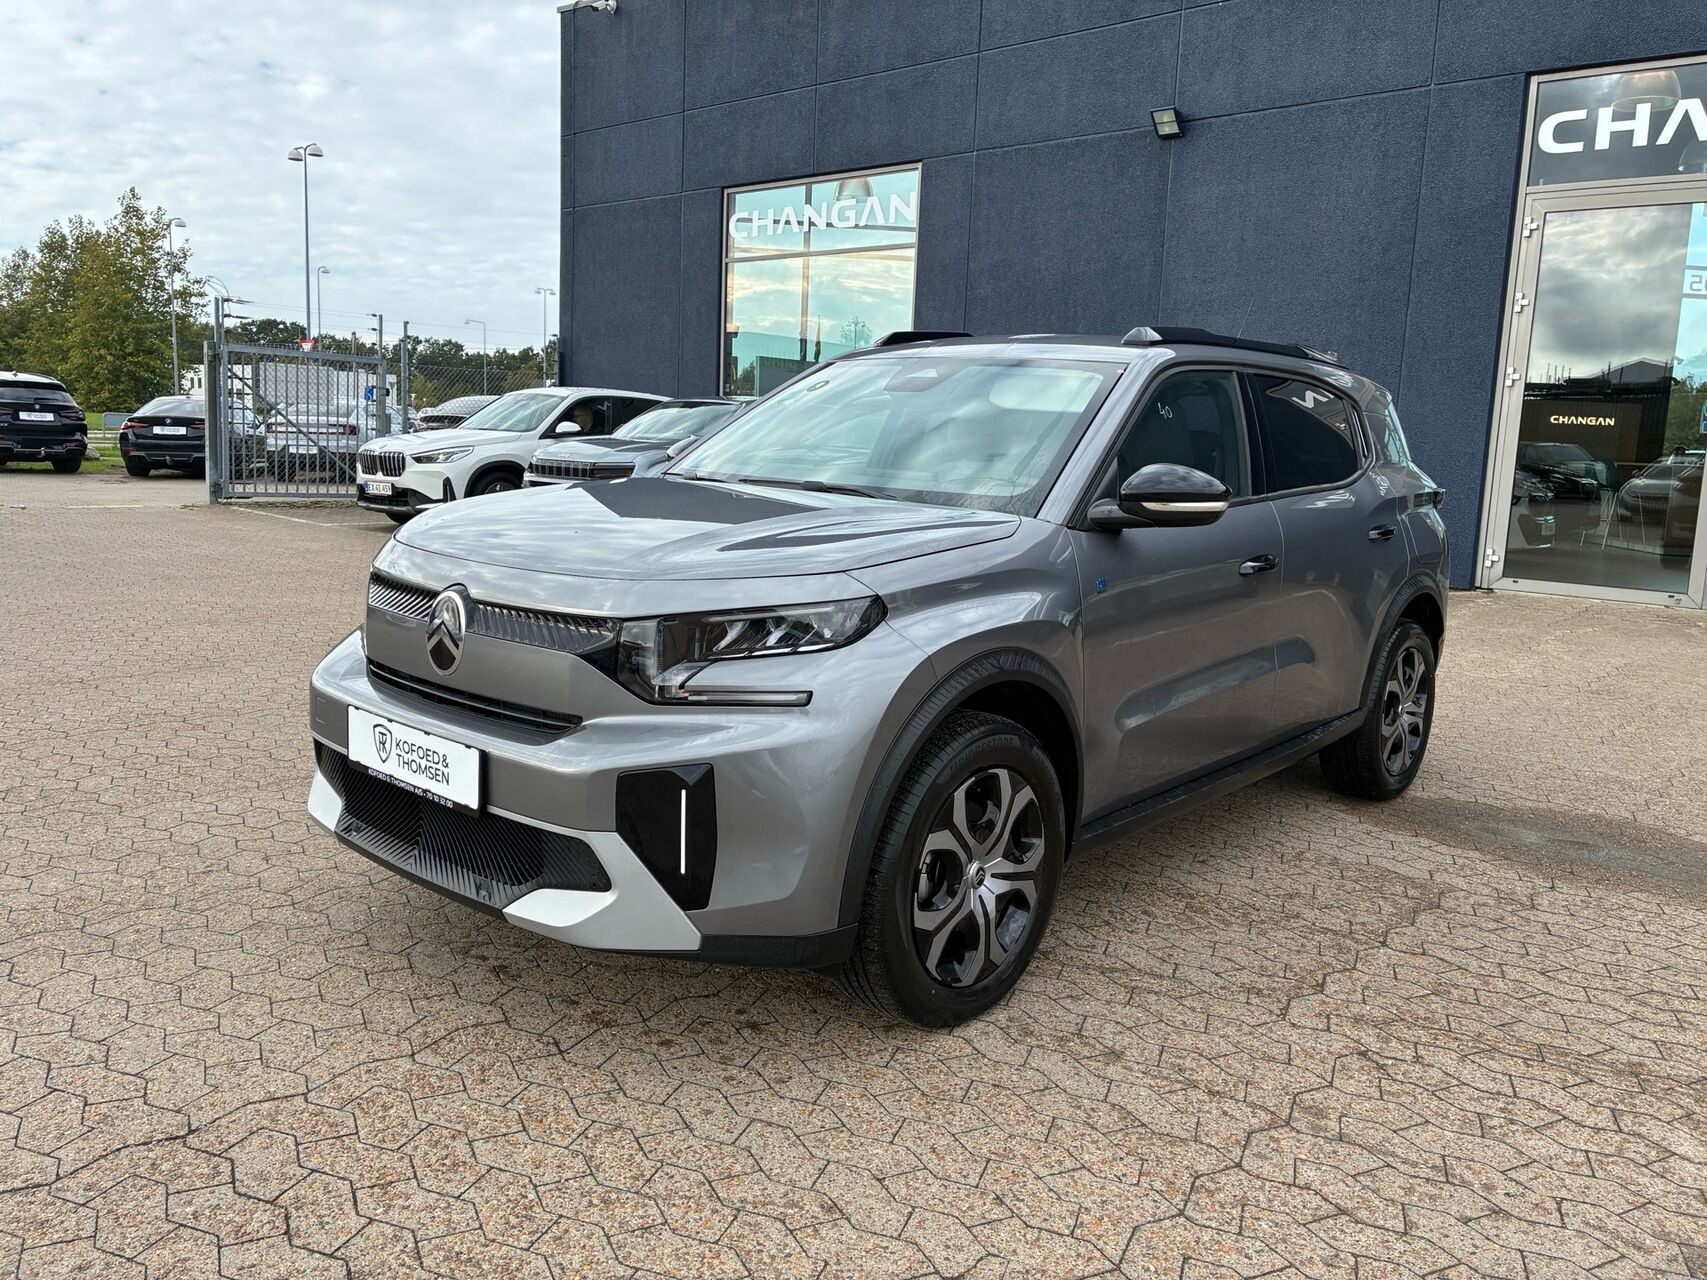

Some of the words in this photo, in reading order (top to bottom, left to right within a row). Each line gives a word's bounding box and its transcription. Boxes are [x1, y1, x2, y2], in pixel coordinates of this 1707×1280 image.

[729, 191, 916, 240] CHANGAN
[1157, 401, 1173, 419] 40
[1550, 415, 1615, 426] CHANGAN
[395, 737, 440, 765] KOFOED
[441, 753, 450, 769] &
[368, 768, 386, 781] KOFOED
[391, 777, 415, 793] THOMSEN
[396, 753, 450, 786] THOMSEN
